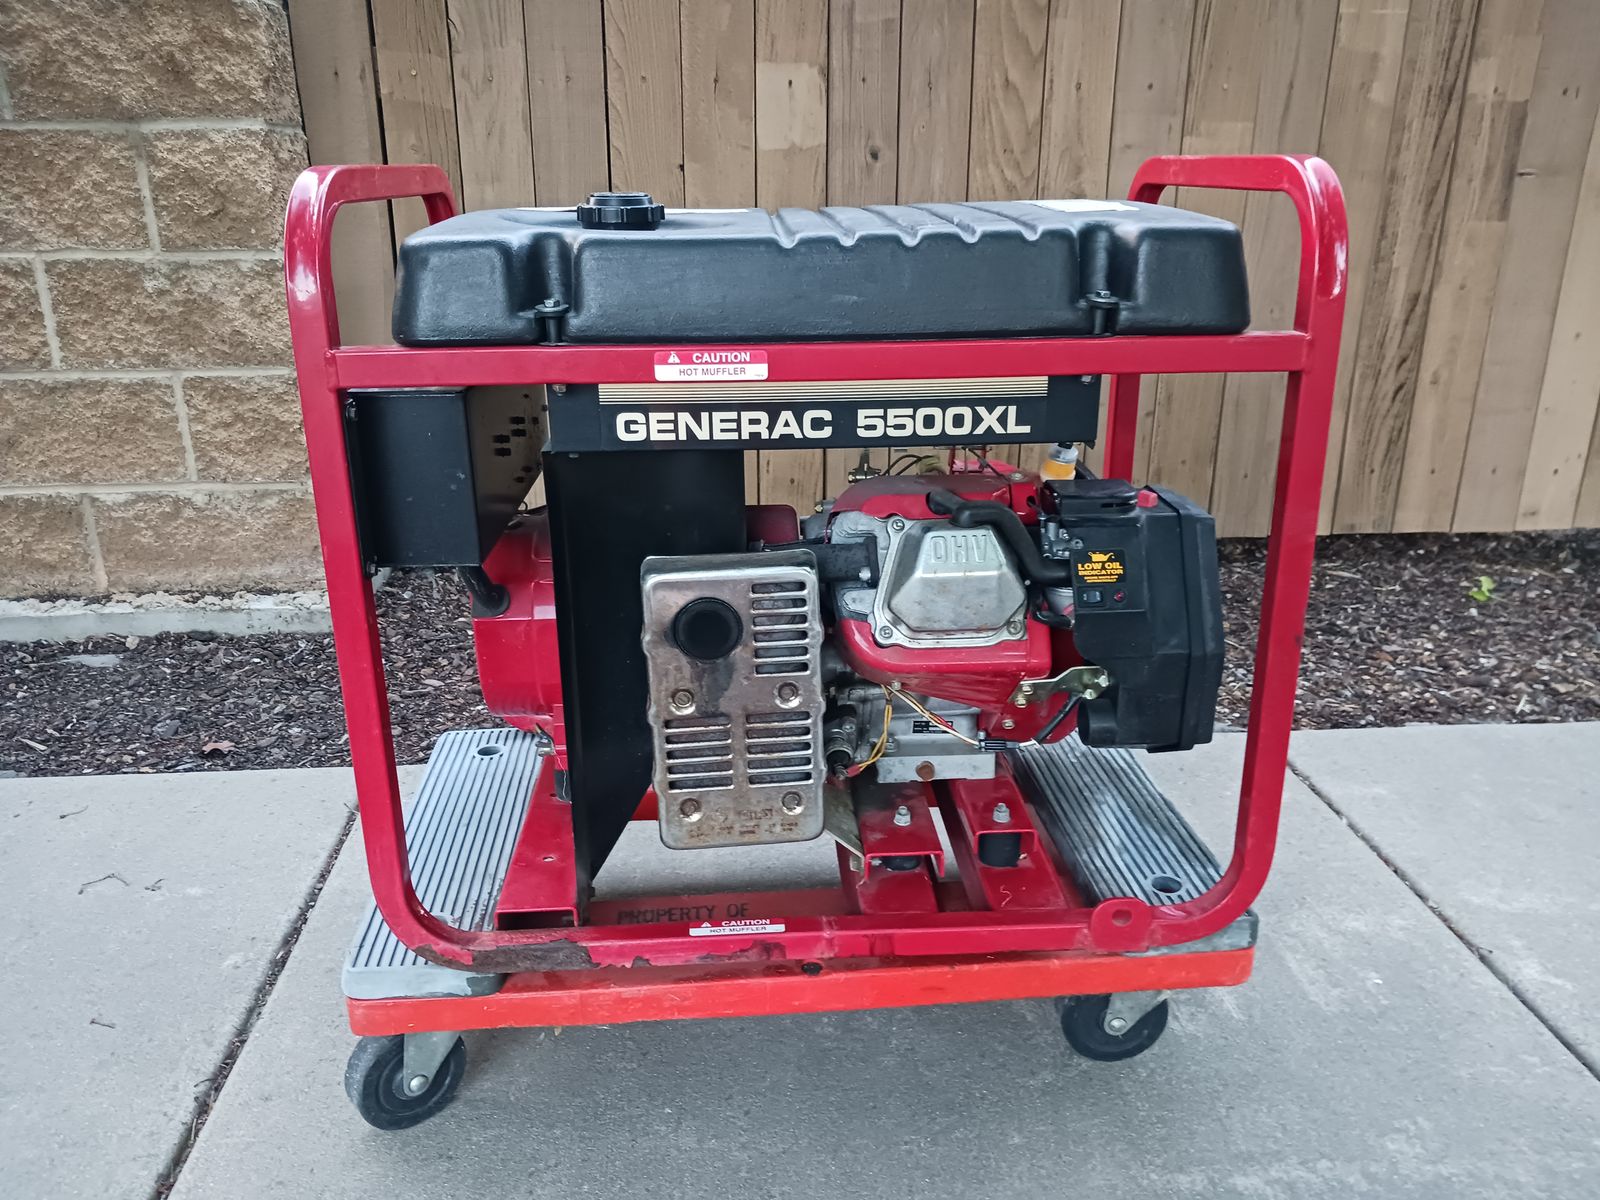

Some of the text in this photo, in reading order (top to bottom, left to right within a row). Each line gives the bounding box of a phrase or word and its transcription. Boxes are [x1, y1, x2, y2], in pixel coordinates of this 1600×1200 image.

[692, 352, 751, 364] CAUTION
[679, 368, 699, 377] HOT
[702, 367, 746, 376] MUFFLER
[616, 405, 1032, 442] GENERAC 5500XL
[930, 533, 988, 564] OHV
[1077, 561, 1124, 570] LOW OIL
[617, 902, 750, 924] PROPERTY OF
[721, 918, 771, 927] CAUTION
